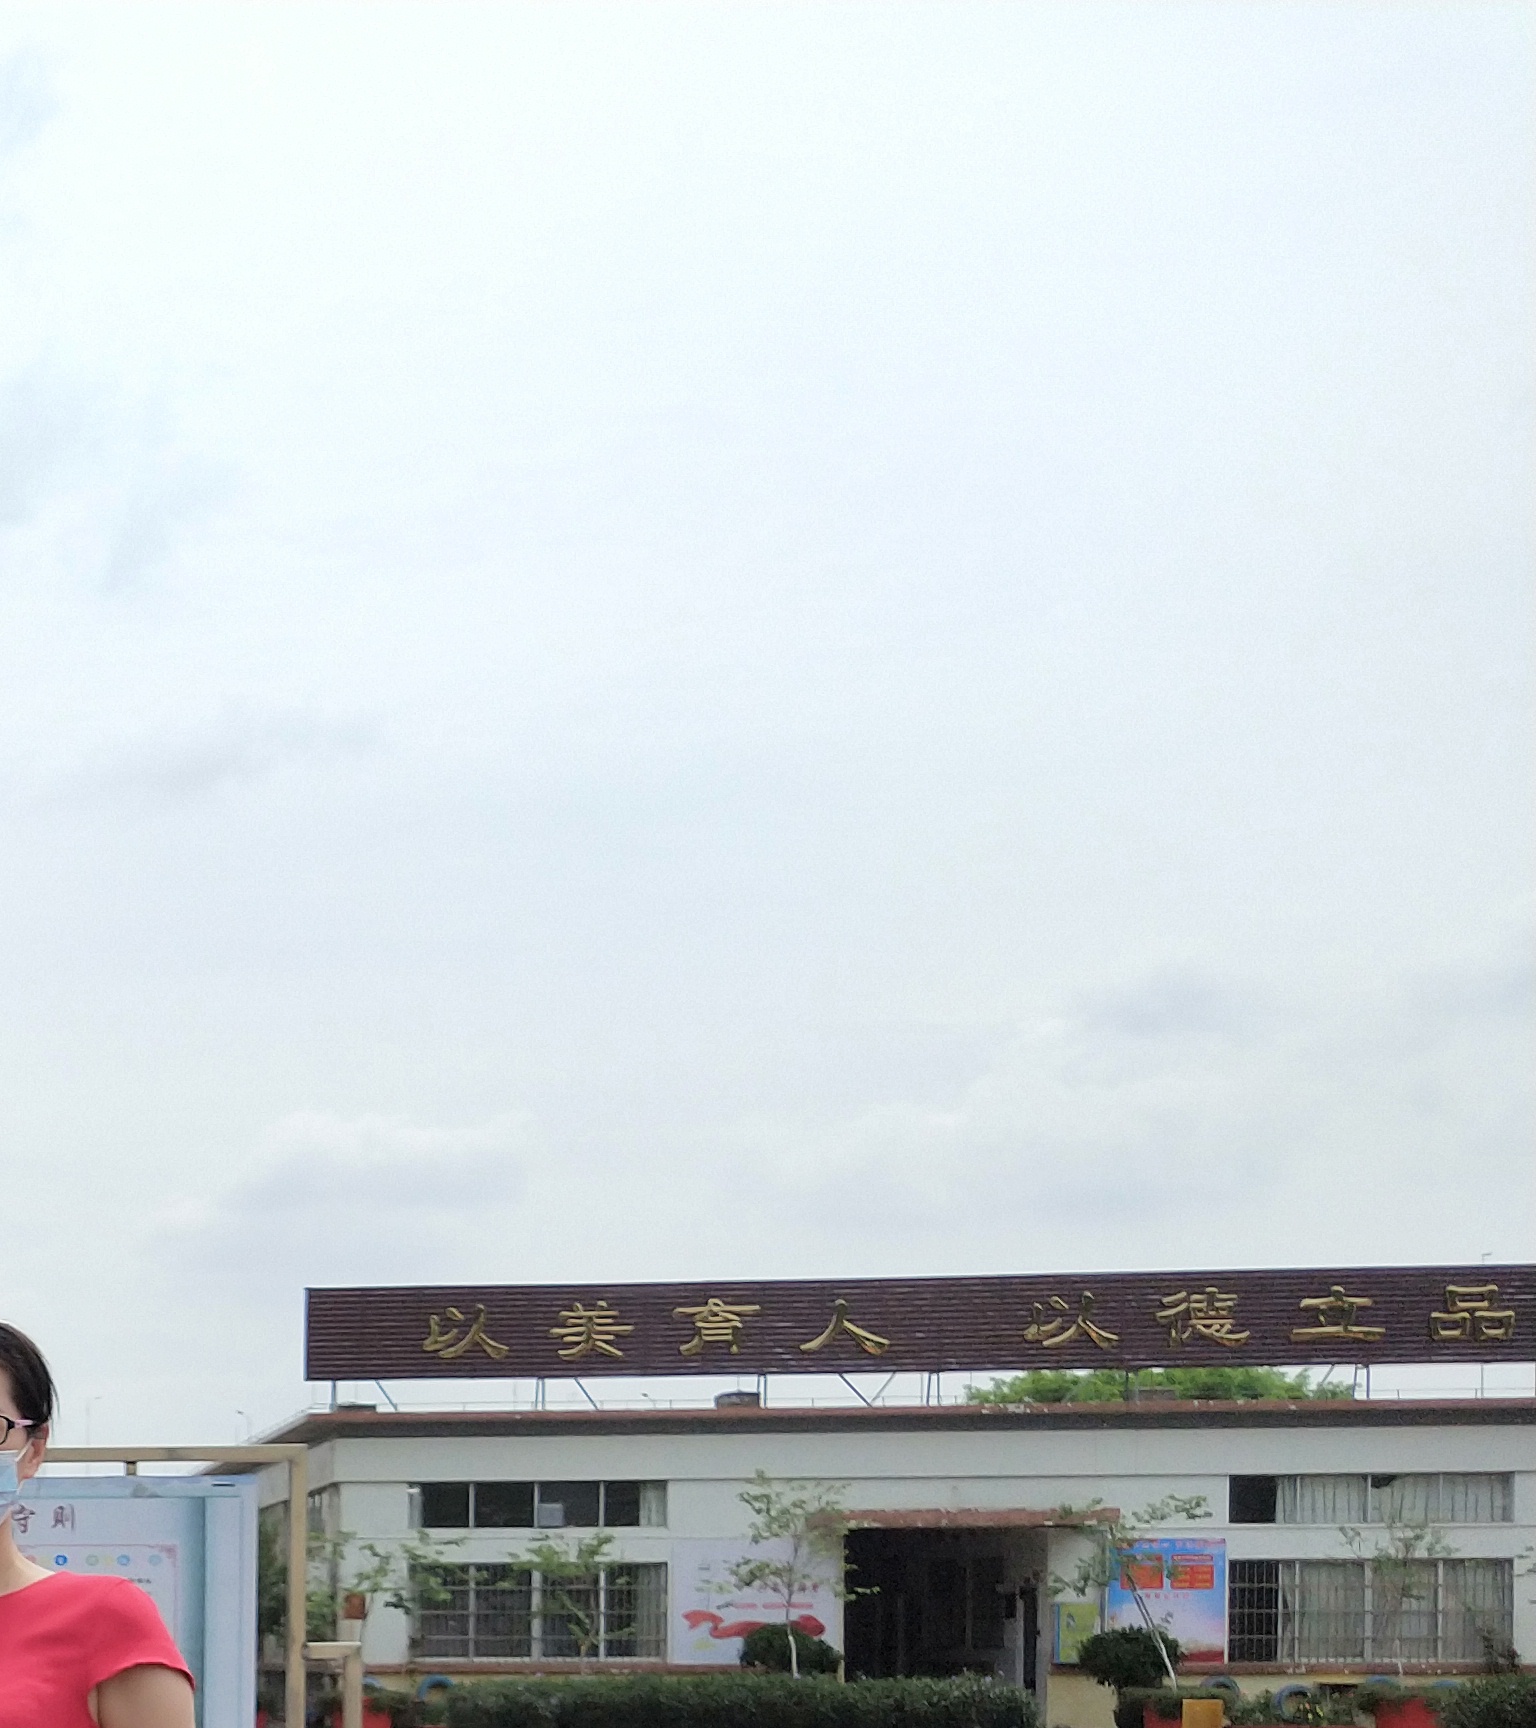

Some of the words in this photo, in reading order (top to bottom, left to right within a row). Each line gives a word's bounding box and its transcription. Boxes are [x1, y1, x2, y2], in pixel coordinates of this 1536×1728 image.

[422, 1297, 891, 1361] 以美育人
[1023, 1284, 1516, 1350] 以德立品
